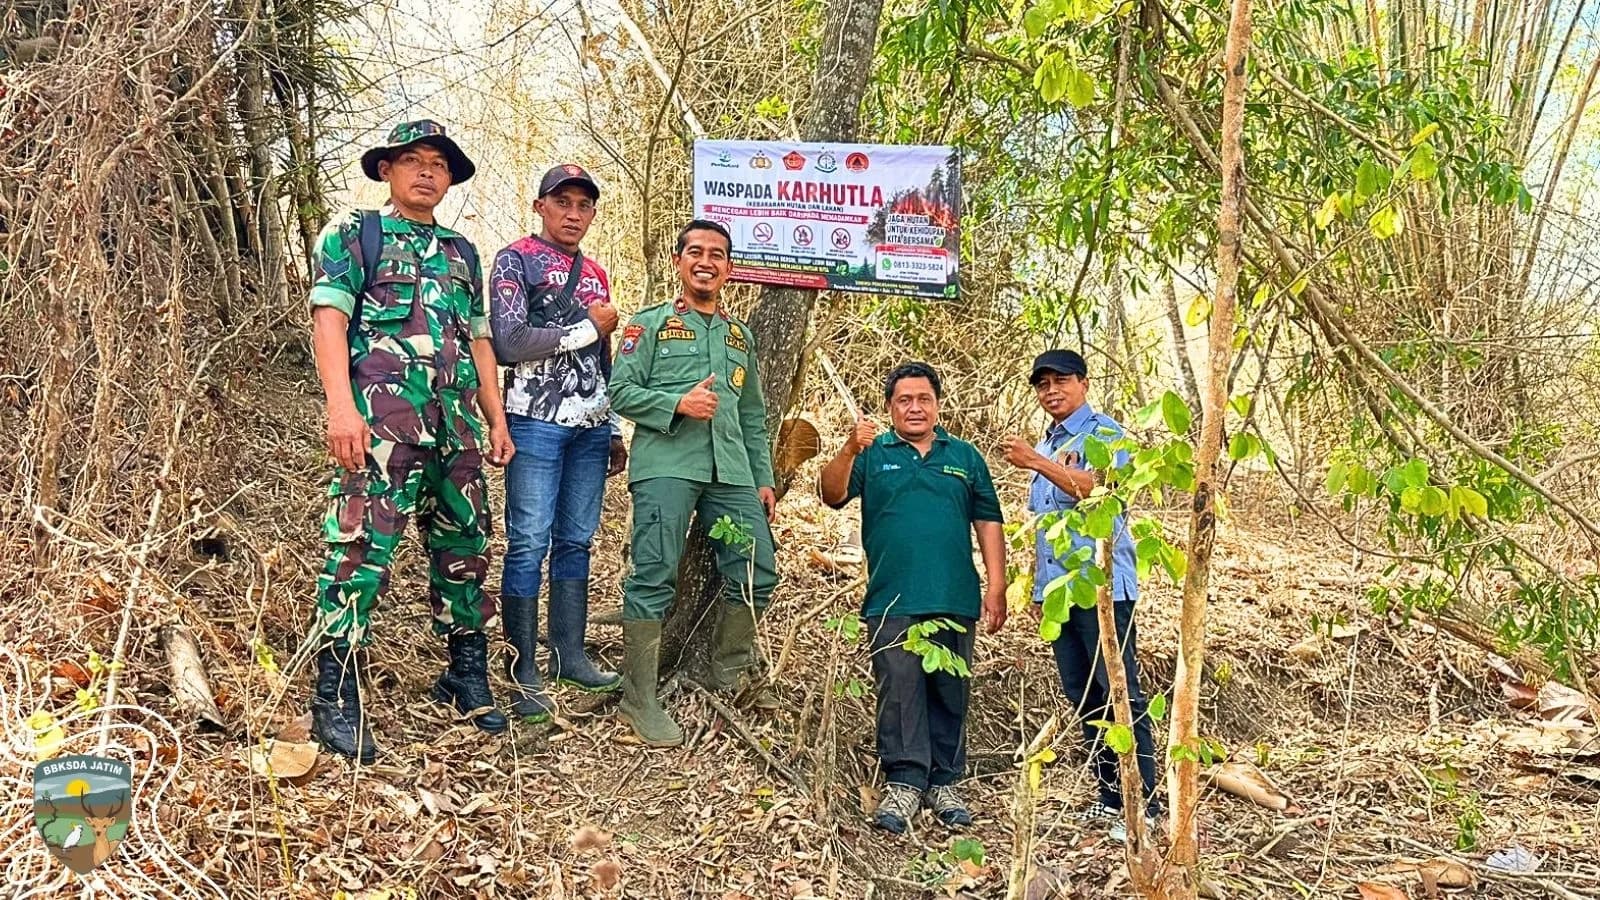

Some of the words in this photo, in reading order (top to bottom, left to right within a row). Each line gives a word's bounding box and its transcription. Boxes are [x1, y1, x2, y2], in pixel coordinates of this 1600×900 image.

[704, 180, 773, 199] WASPADA
[777, 180, 884, 207] KARHUTLA
[711, 205, 749, 216] MENCEGAH
[750, 209, 770, 217] LEBIH
[788, 210, 820, 219] DARIPADA
[821, 214, 863, 223] MEMADAMKAN
[888, 214, 904, 223] JAGA
[906, 215, 929, 224] HUTAN
[887, 225, 908, 233] UNTUK
[909, 226, 945, 235] KEHIDUPAN
[887, 235, 902, 243] KITA
[903, 236, 934, 245] BERSAMA
